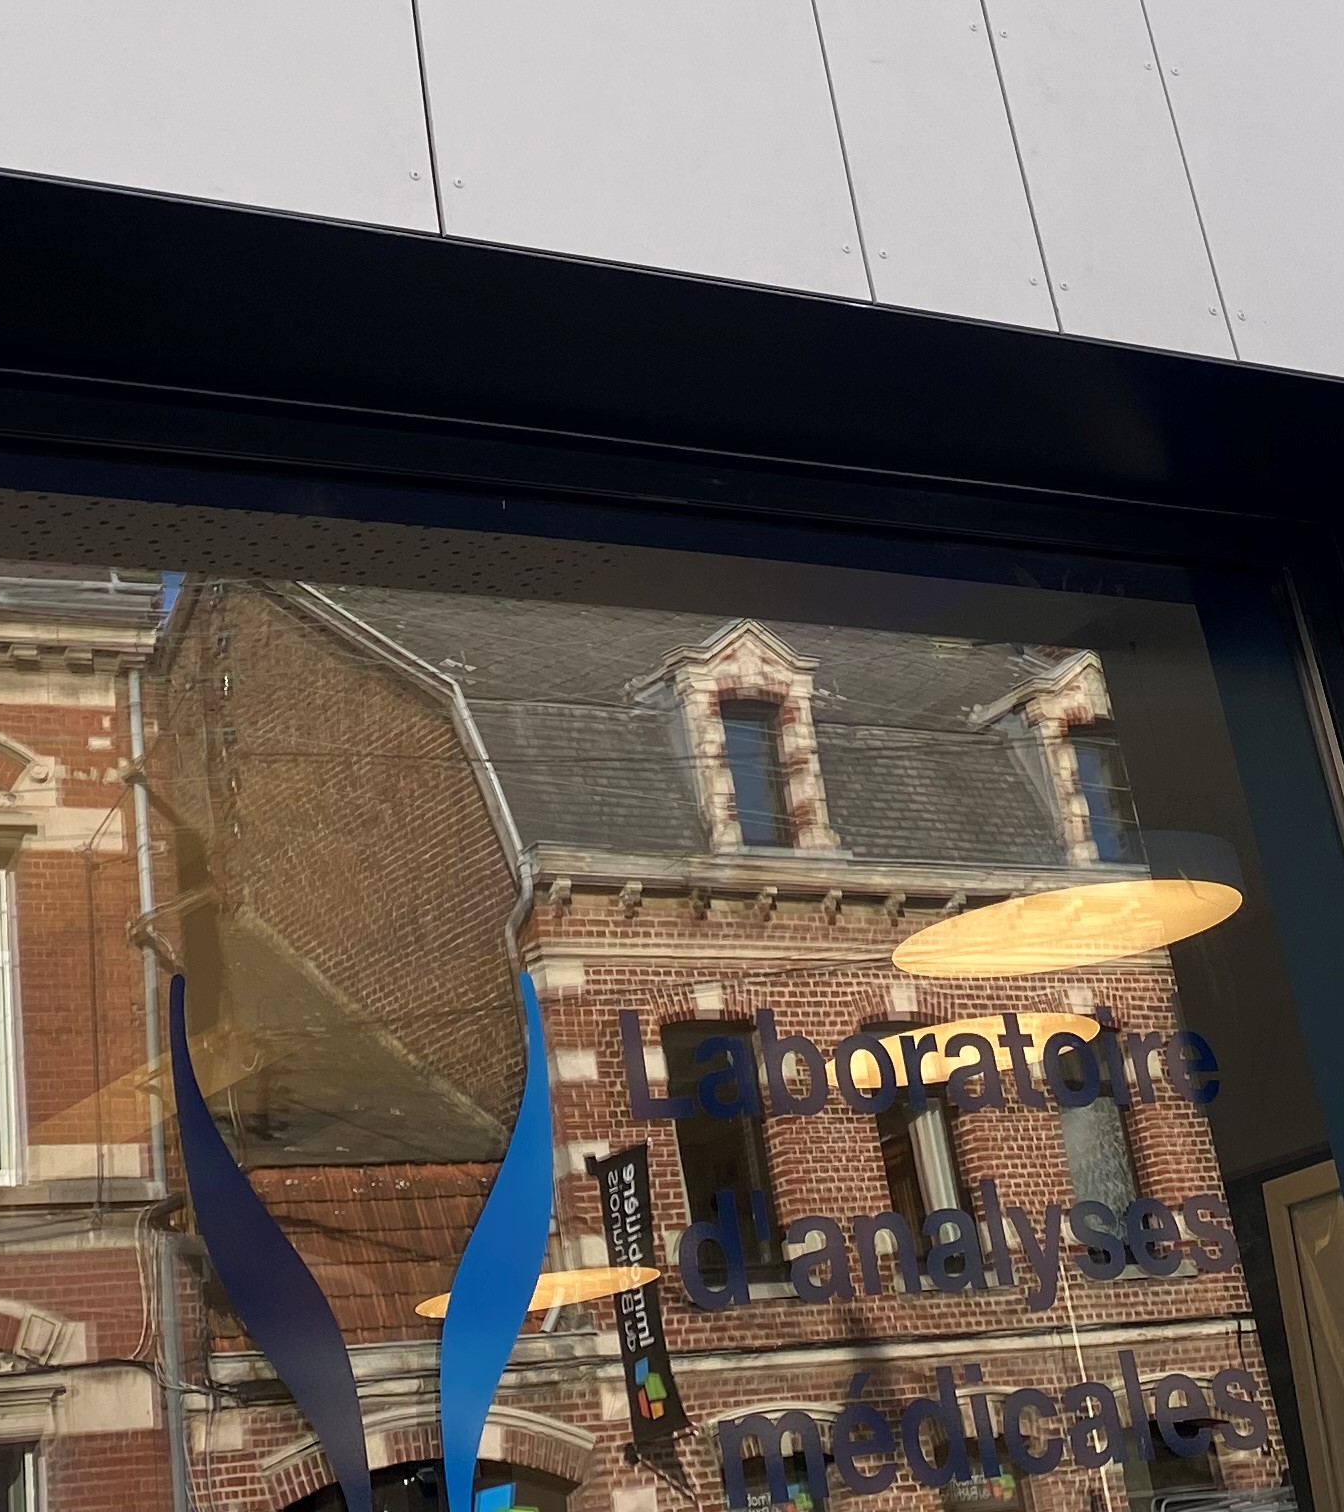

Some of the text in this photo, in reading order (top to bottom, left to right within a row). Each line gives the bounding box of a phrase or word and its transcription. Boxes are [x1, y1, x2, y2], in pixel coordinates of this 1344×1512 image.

[619, 1007, 1220, 1119] Laboratoire
[679, 1180, 1239, 1312] d'analyses
[718, 1350, 1268, 1509] médicales
